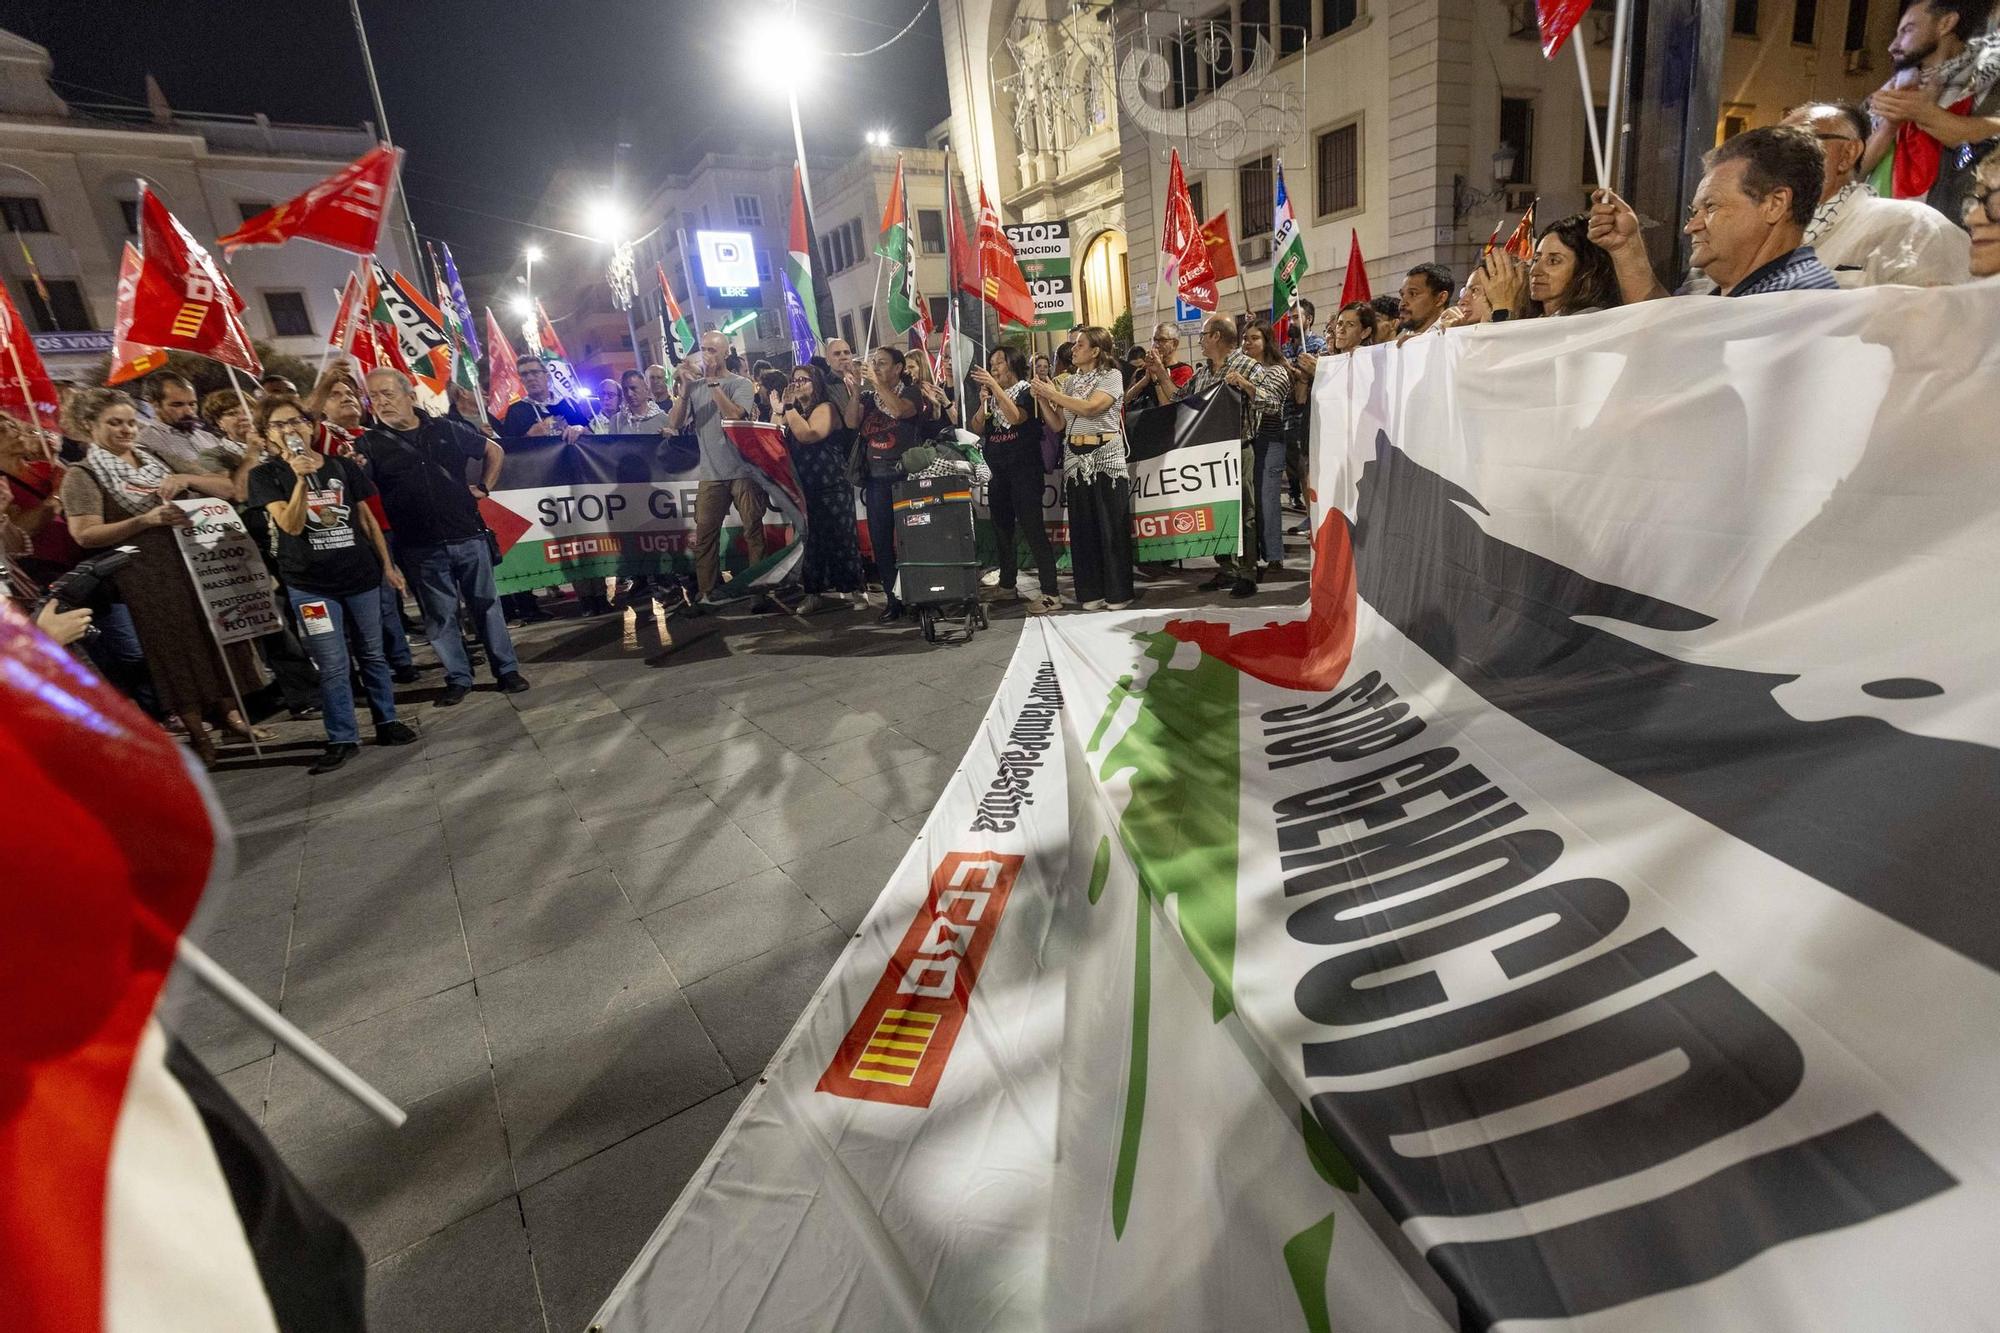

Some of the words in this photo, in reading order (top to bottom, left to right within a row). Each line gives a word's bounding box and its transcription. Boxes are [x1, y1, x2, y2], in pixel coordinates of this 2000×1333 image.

[1007, 224, 1062, 242] STOP
[1014, 244, 1062, 256] ENOCIDIO
[719, 286, 749, 297] LIBRE
[1027, 279, 1064, 297] TOP
[1129, 451, 1240, 499] ALESTÍ!
[201, 504, 230, 517] STOP
[537, 494, 627, 527] STOP
[547, 542, 598, 559] CCOO
[640, 534, 682, 552] UGT
[223, 612, 278, 632] FLOTILLA
[1260, 670, 1428, 771] STOP
[896, 859, 1003, 1000] CCOO
[1272, 747, 1961, 1333] GENOCIDI
